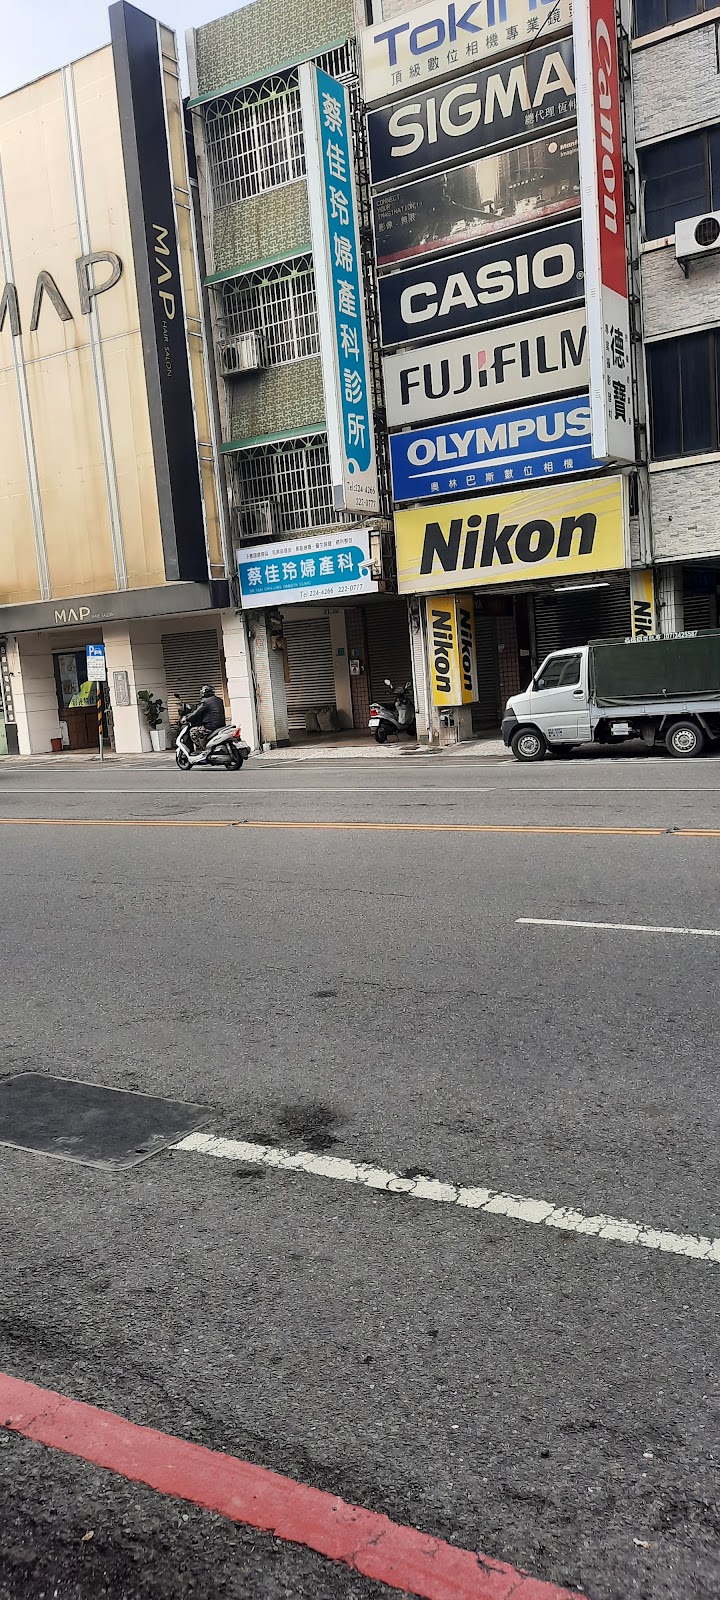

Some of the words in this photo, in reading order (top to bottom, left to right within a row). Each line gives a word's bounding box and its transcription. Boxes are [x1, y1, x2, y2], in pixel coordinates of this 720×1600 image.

[387, 51, 576, 158] SIGMA
[594, 17, 619, 236] Canon
[151, 223, 176, 320] MAP
[321, 91, 366, 450] 蔡佳玲婦產科診所
[400, 245, 576, 325] CASIO
[161, 320, 169, 343] HAIR
[163, 346, 173, 378] SALON
[399, 324, 588, 407] FUJIFILM
[406, 406, 592, 467] OLYMPUS
[430, 457, 575, 493] 奧林巴斯數位相機
[246, 551, 354, 586] 蔡佳玲婦產科
[418, 511, 598, 576] Nikon
[54, 606, 91, 624] MAP
[88, 645, 95, 657] P
[432, 609, 453, 693] Nikon
[459, 607, 474, 692] Nikon
